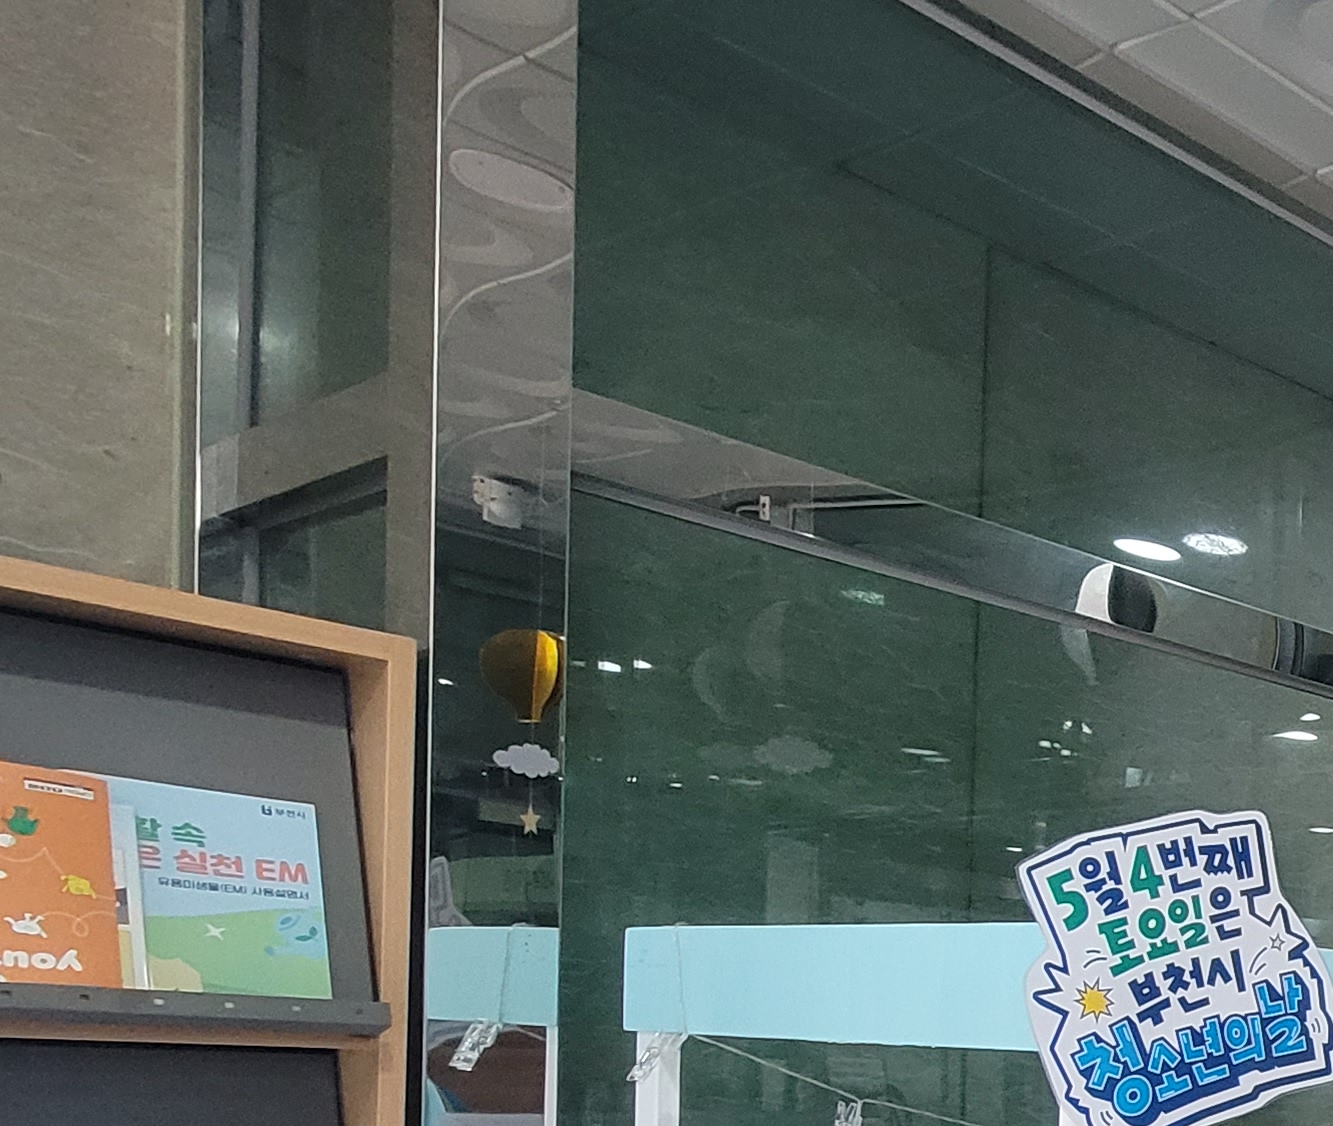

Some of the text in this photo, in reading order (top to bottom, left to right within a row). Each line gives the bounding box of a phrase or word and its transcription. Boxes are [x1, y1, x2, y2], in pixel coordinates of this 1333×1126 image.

[171, 822, 207, 847] 속
[173, 849, 245, 878] 실천
[255, 859, 309, 885] EM
[252, 887, 309, 900] 사용설명서
[1046, 835, 1254, 932] 5월 4번째
[1097, 886, 1242, 977] 토요일은
[1128, 949, 1246, 1026] 부천시
[1075, 972, 1311, 1117] 청소년의 날
